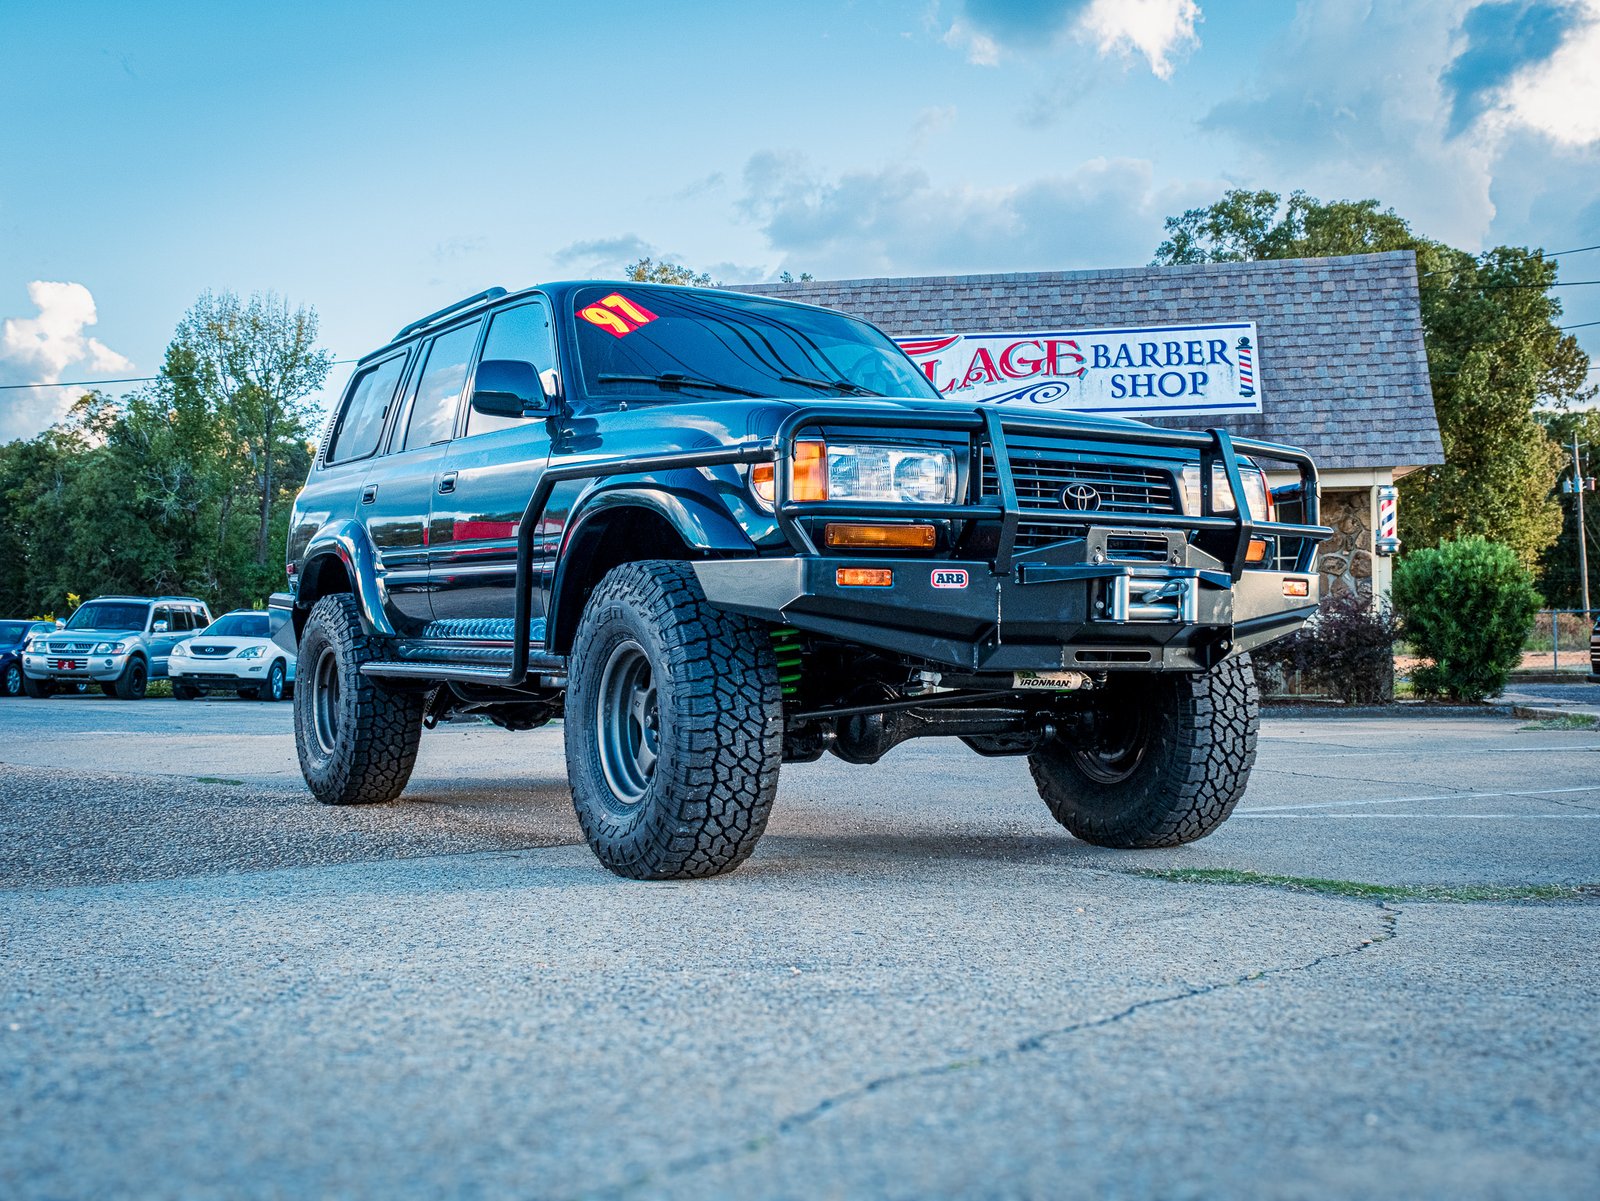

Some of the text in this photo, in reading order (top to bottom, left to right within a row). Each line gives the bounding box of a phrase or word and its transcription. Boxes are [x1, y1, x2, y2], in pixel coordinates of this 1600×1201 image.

[581, 295, 649, 333] 97
[1088, 339, 1234, 369] BARBER
[1111, 371, 1209, 399] SHOP
[936, 573, 965, 584] ARB
[1020, 679, 1069, 688] IRONMAN
